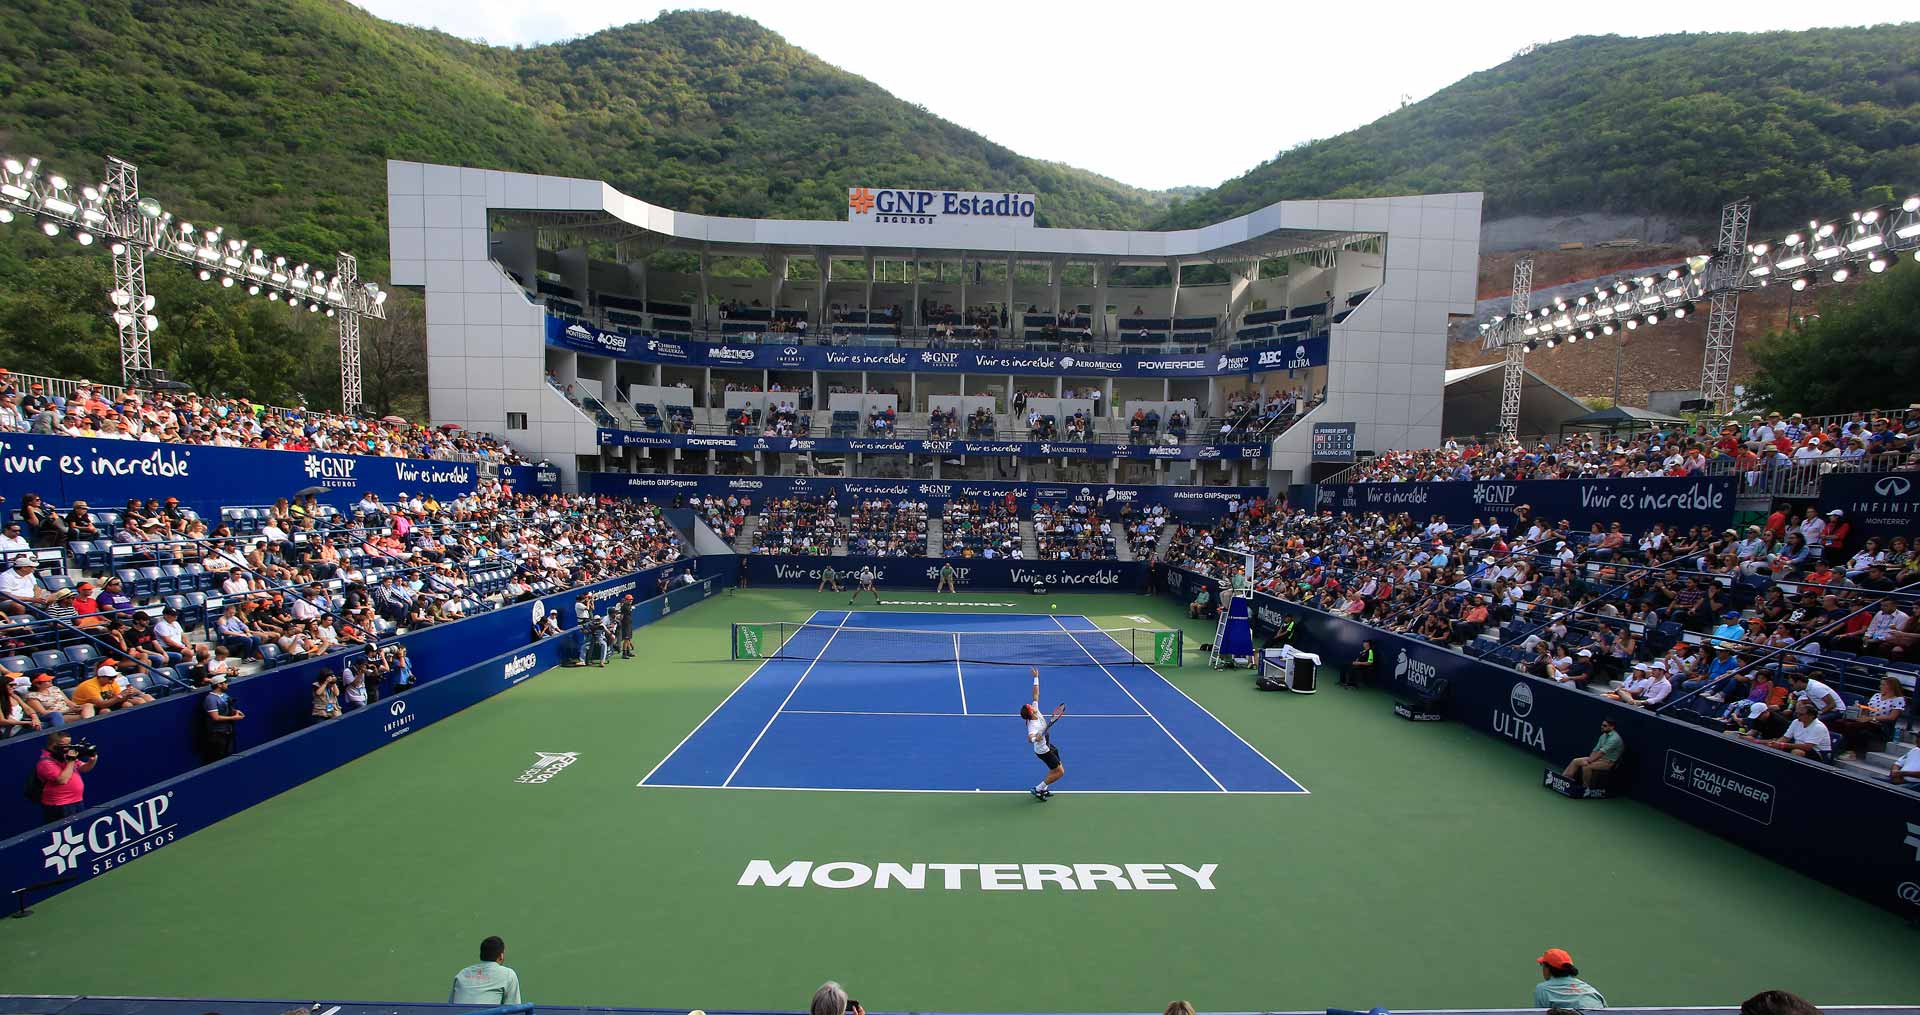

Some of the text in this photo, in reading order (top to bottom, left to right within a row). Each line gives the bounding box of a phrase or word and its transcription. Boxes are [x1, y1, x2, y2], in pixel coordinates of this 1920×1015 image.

[876, 191, 1035, 217] GNP Estadio
[876, 216, 934, 224] SEGUROS
[826, 352, 850, 363] Vivir
[852, 355, 861, 363] es
[932, 353, 957, 362] GNP
[976, 355, 999, 366] Vivir
[1001, 359, 1010, 367] es
[1138, 361, 1205, 369] POWERADE
[1258, 350, 1281, 364] ABC
[1288, 358, 1310, 368] ULTRA
[931, 441, 952, 450] GNP
[60, 455, 84, 475] es
[91, 447, 189, 477] increíble
[321, 457, 355, 478] GNP
[396, 462, 419, 481] Vivir
[421, 472, 430, 483] es
[844, 483, 864, 493] Vivir
[928, 485, 951, 493] GNP
[962, 487, 981, 496] Vivir
[1367, 487, 1384, 503] Vivir
[1485, 485, 1515, 503] GNP
[1582, 483, 1723, 510] Vivir es increíble
[775, 564, 806, 579] Vivir
[809, 569, 821, 579] es
[1046, 574, 1057, 584] es
[1061, 569, 1119, 584] increíble
[1408, 658, 1436, 678] NUEVO
[384, 713, 415, 733] INFINITI
[1493, 709, 1546, 751] ULTRA
[1692, 777, 1722, 797] TOUR
[1693, 767, 1770, 803] CHALLENGER
[88, 794, 169, 854] GNP
[93, 831, 175, 875] SEGUROS
[736, 859, 1219, 890] MONTERREY
